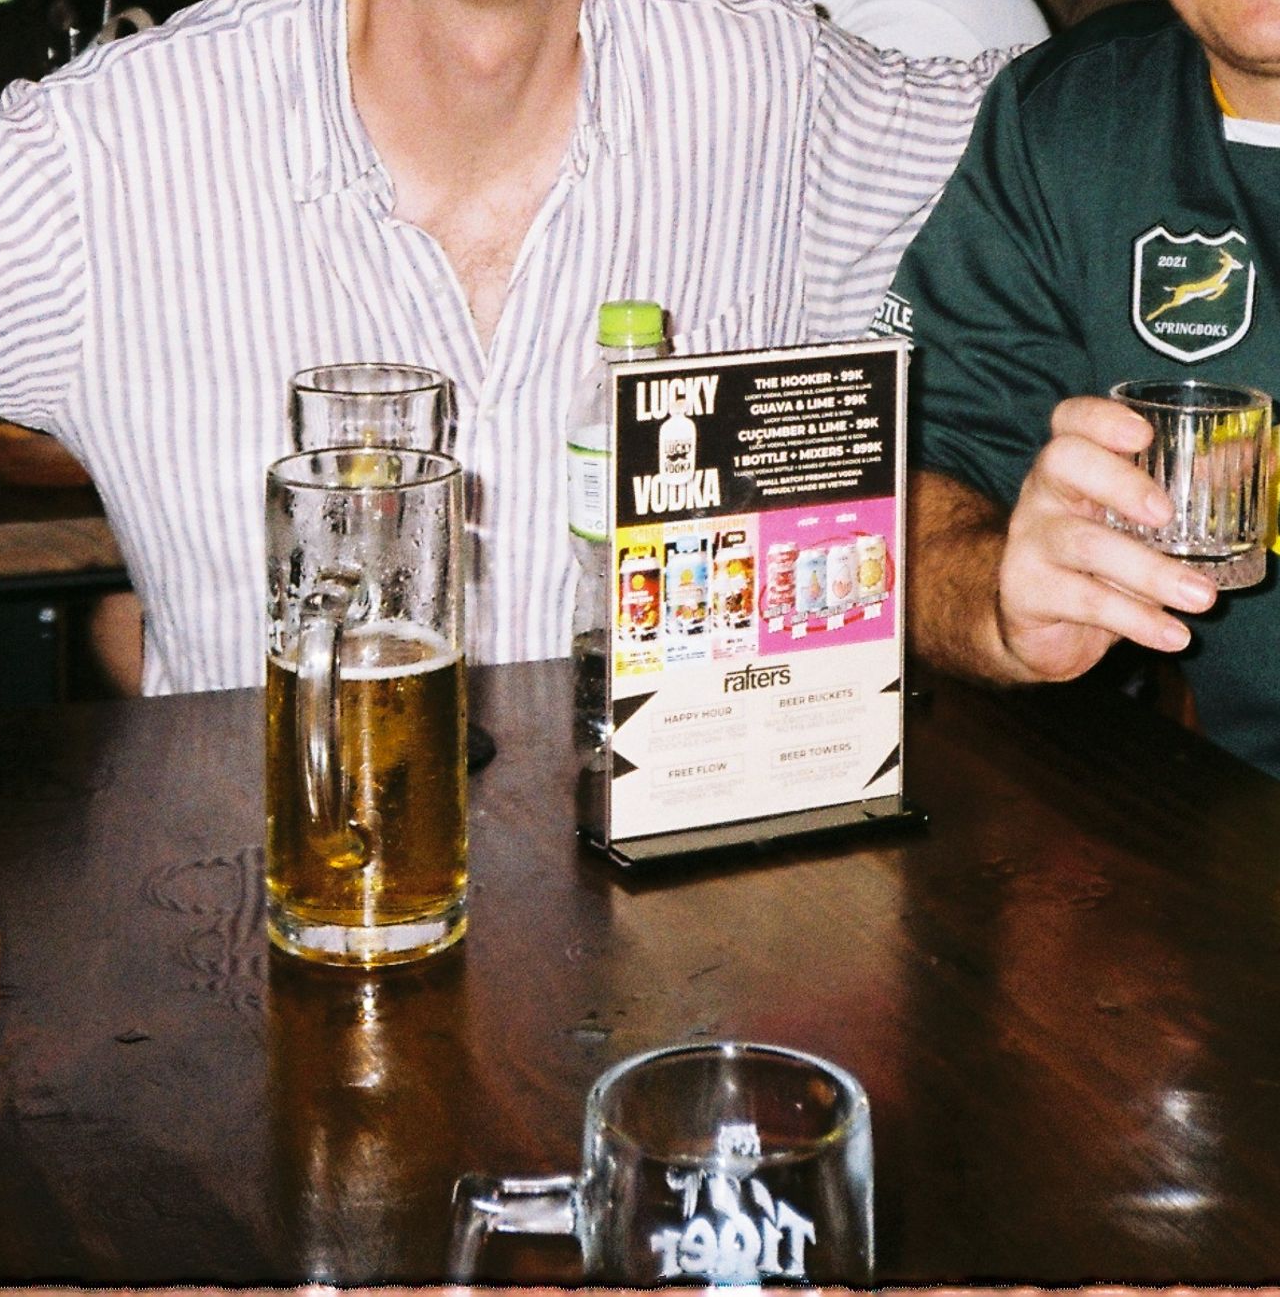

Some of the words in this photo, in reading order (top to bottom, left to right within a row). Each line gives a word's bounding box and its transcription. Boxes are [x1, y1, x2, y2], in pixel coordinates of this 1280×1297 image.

[1158, 255, 1187, 267] 2021
[1154, 321, 1228, 337] SPRINGBOKS
[754, 377, 779, 390] THE
[780, 372, 832, 388] HOOKER
[840, 369, 864, 382] 99K
[636, 375, 719, 422] LUCKY
[750, 401, 794, 415] GUAVA
[796, 400, 804, 411] &
[807, 396, 835, 410] LIME
[844, 394, 867, 406] 99K
[738, 425, 806, 442] CUCUMBER
[808, 423, 816, 434] &
[818, 420, 847, 434] LIME
[856, 417, 879, 430] 99K
[734, 456, 740, 468] 1
[741, 451, 788, 467] BOTTLE
[799, 445, 844, 461] MIXERS
[852, 441, 883, 454] 899K
[756, 478, 779, 487] SMALL
[780, 476, 804, 484] BATCH
[838, 469, 863, 477] VODKA
[762, 486, 796, 496] PROUDLY
[827, 479, 858, 488] VIETNAM
[632, 468, 721, 515] VODKA
[724, 663, 791, 693] rafters
[780, 696, 805, 708] BEER
[808, 689, 853, 703] BUCKETS
[664, 712, 699, 724] HAPPY
[702, 706, 732, 718] HOUR
[780, 750, 806, 762] BEER
[809, 743, 852, 756] TOWERS
[668, 767, 694, 778] FREE
[697, 763, 727, 774] FLOW
